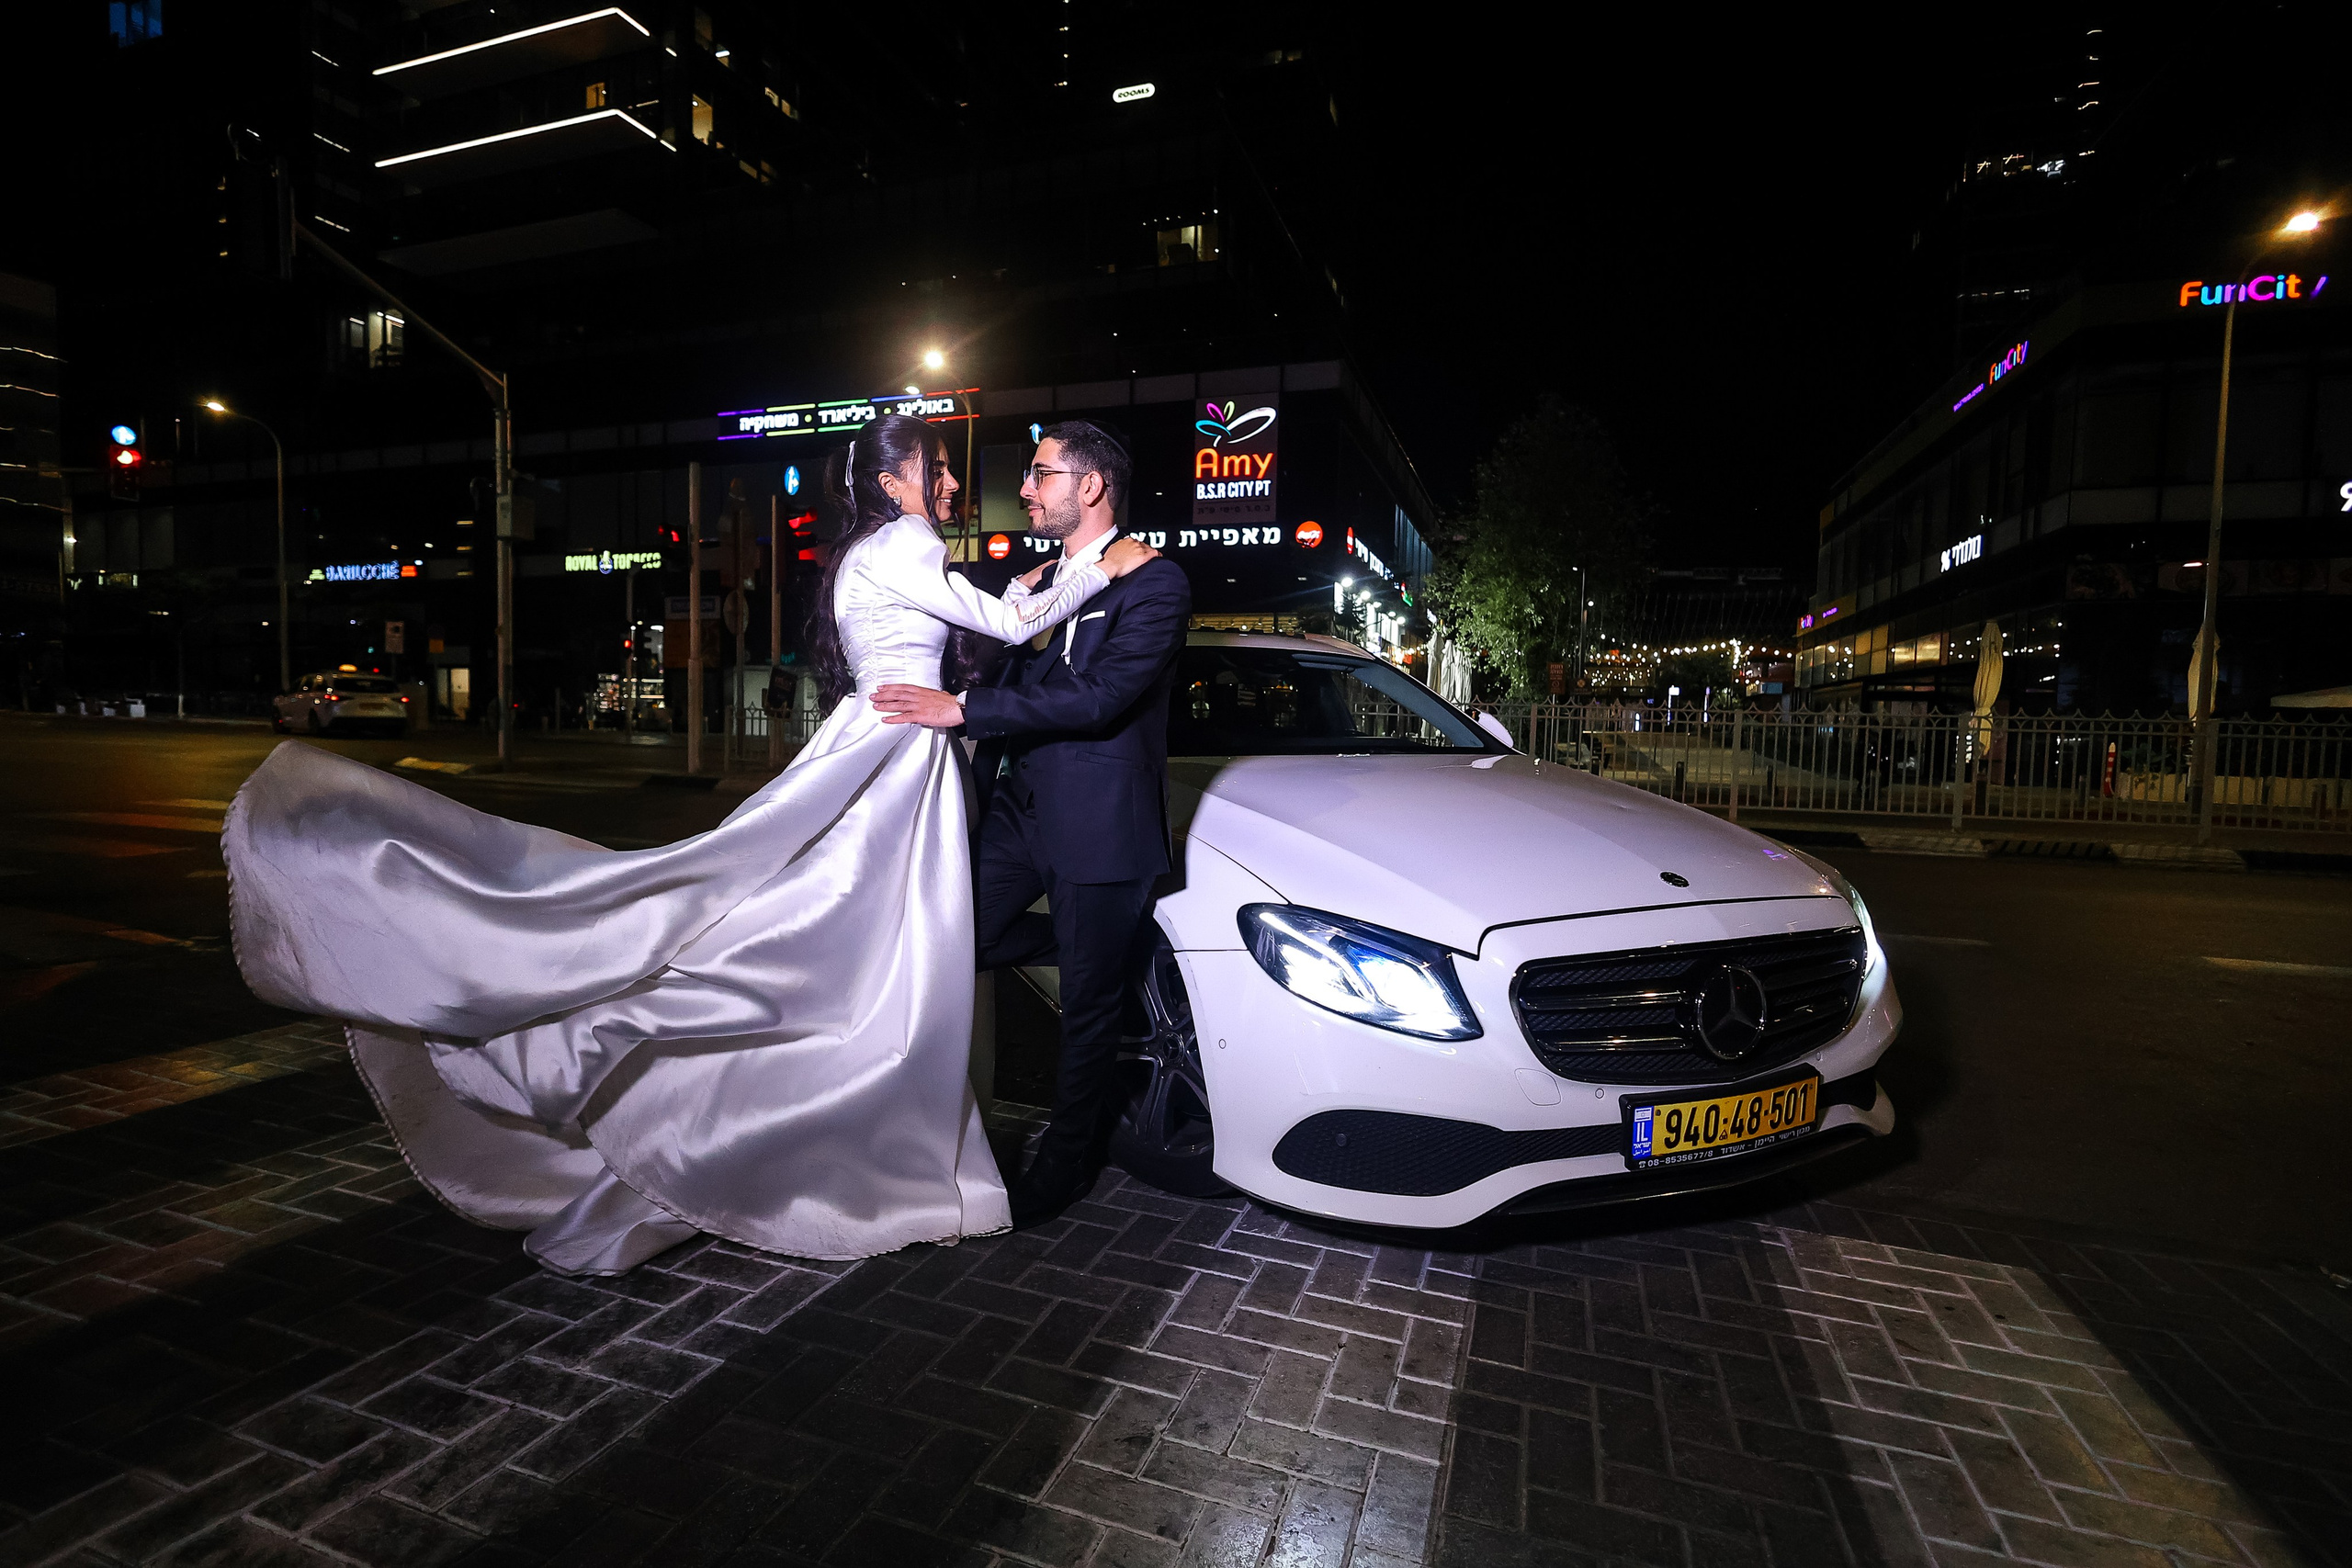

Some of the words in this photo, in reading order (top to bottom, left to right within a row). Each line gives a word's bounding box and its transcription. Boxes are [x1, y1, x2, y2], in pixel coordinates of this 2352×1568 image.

[1117, 87, 1150, 98] ROOMS
[1988, 340, 2030, 386] FunCity
[739, 412, 799, 434] משחקיה
[817, 405, 876, 425] ביליארד
[1195, 447, 1274, 479] Amy
[1227, 481, 1256, 499] CITY
[1255, 479, 1272, 497] PT
[1178, 525, 1281, 547] מאפיית
[565, 555, 598, 571] ROYAL
[1636, 1122, 1648, 1143] IL
[1754, 1135, 1775, 1149] היימן
[1647, 1150, 1713, 1167] 08-8535677/8
[1720, 1144, 1746, 1155] אשדוד
